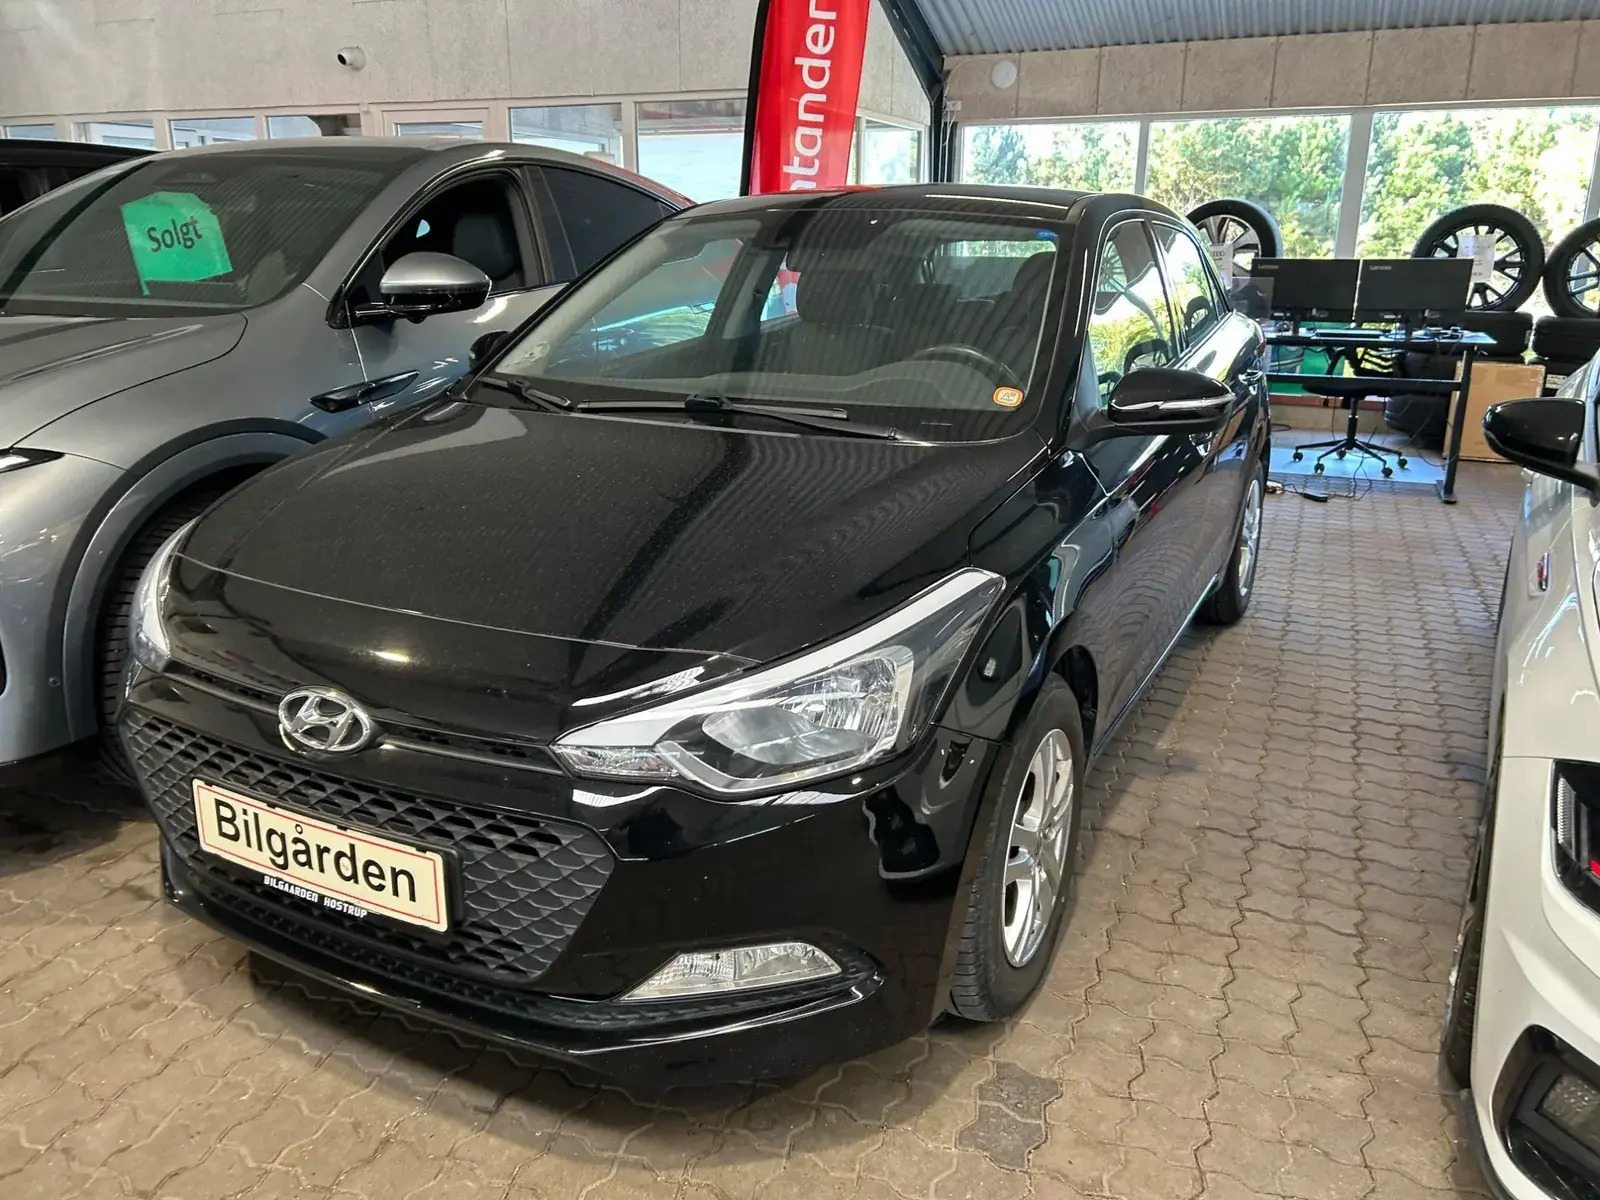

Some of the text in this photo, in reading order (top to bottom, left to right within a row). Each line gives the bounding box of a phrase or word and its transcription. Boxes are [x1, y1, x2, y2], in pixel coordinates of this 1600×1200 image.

[146, 216, 203, 253] Solgt
[213, 797, 417, 903] Bilgården
[263, 875, 368, 918] BILGAARDEN HOSTRUP
